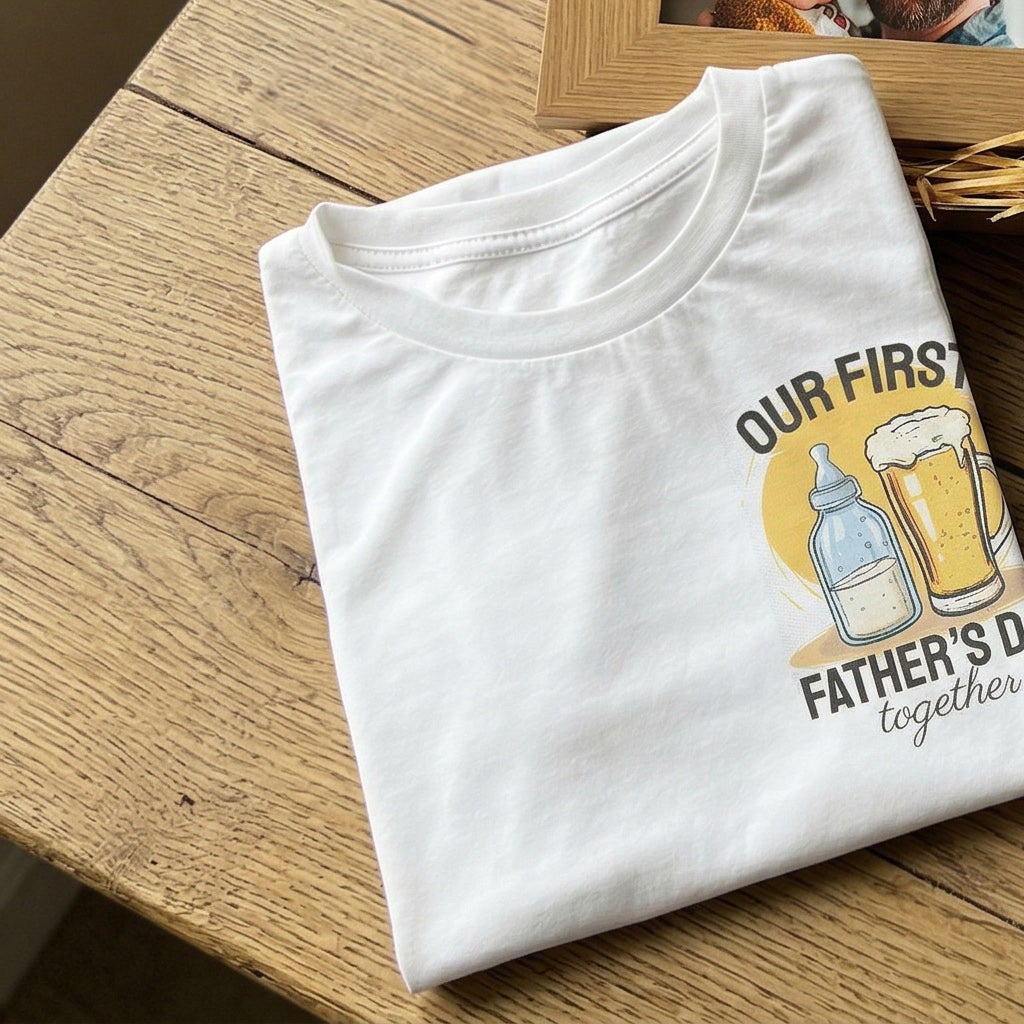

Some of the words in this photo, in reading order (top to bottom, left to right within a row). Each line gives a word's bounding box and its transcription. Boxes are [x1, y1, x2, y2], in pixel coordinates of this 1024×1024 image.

[736, 369, 834, 455] OUR
[799, 621, 992, 721] FATHER’S
[878, 665, 1022, 748] together
